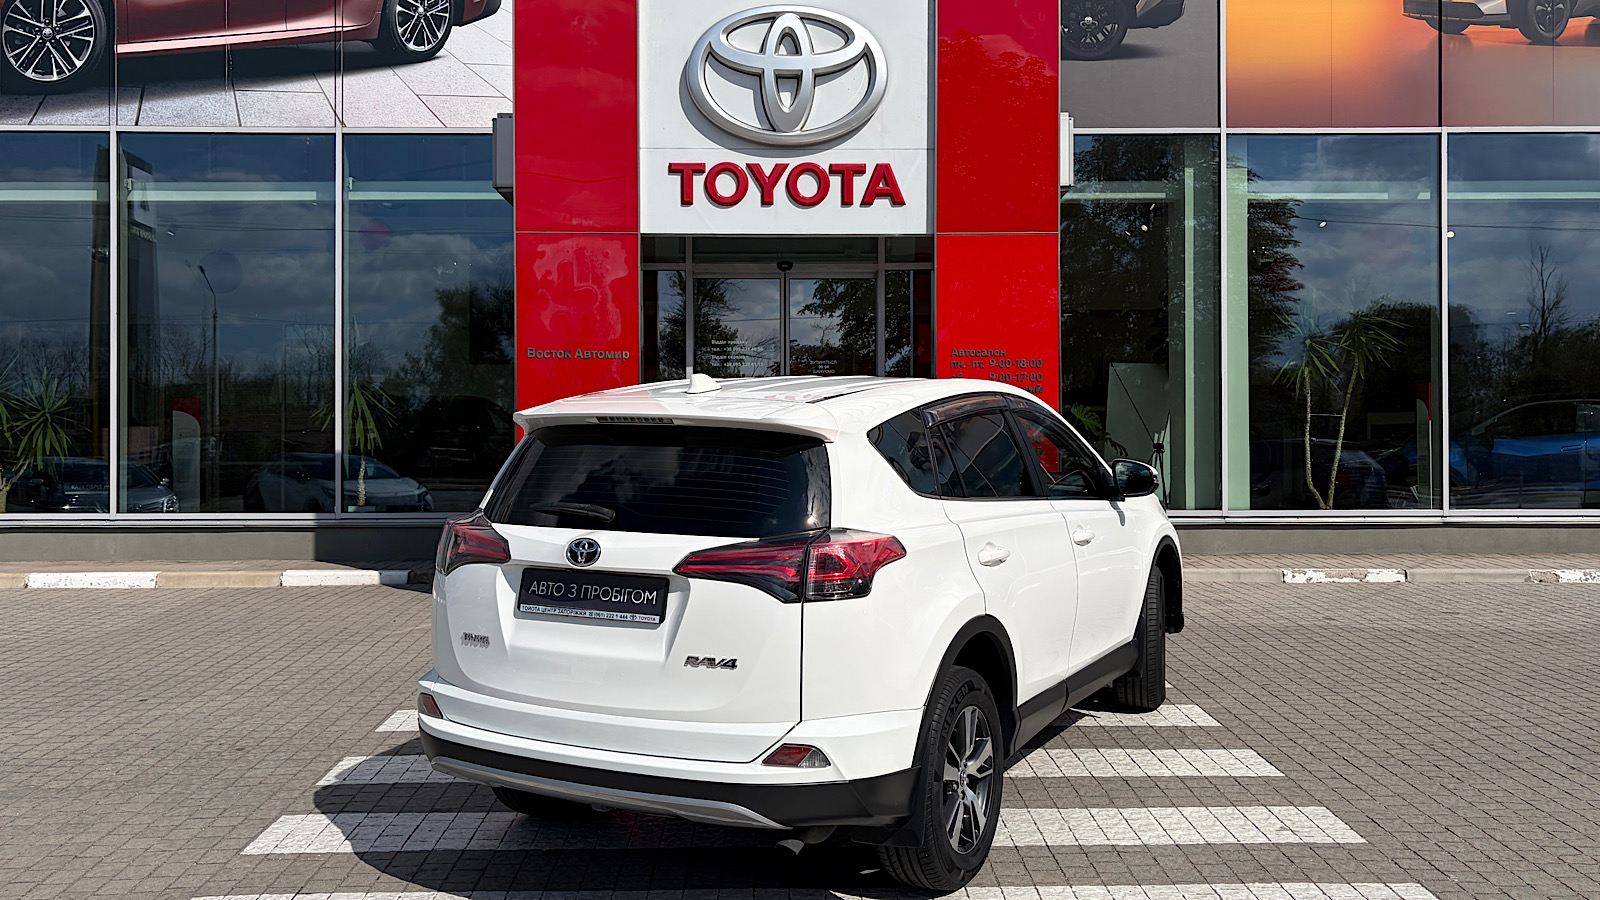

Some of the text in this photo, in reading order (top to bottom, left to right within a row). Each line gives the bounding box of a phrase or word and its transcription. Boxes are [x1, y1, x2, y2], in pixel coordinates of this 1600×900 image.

[668, 161, 906, 208] TOYOTA
[527, 347, 630, 362] Восток Автомир
[951, 347, 1007, 357] Автосалон
[989, 359, 1043, 368] 9:00-18:00
[989, 373, 1043, 382] 9:00-17:00
[528, 580, 657, 605] АВТО З ПРОБІГОМ
[683, 655, 738, 670] RAV4
